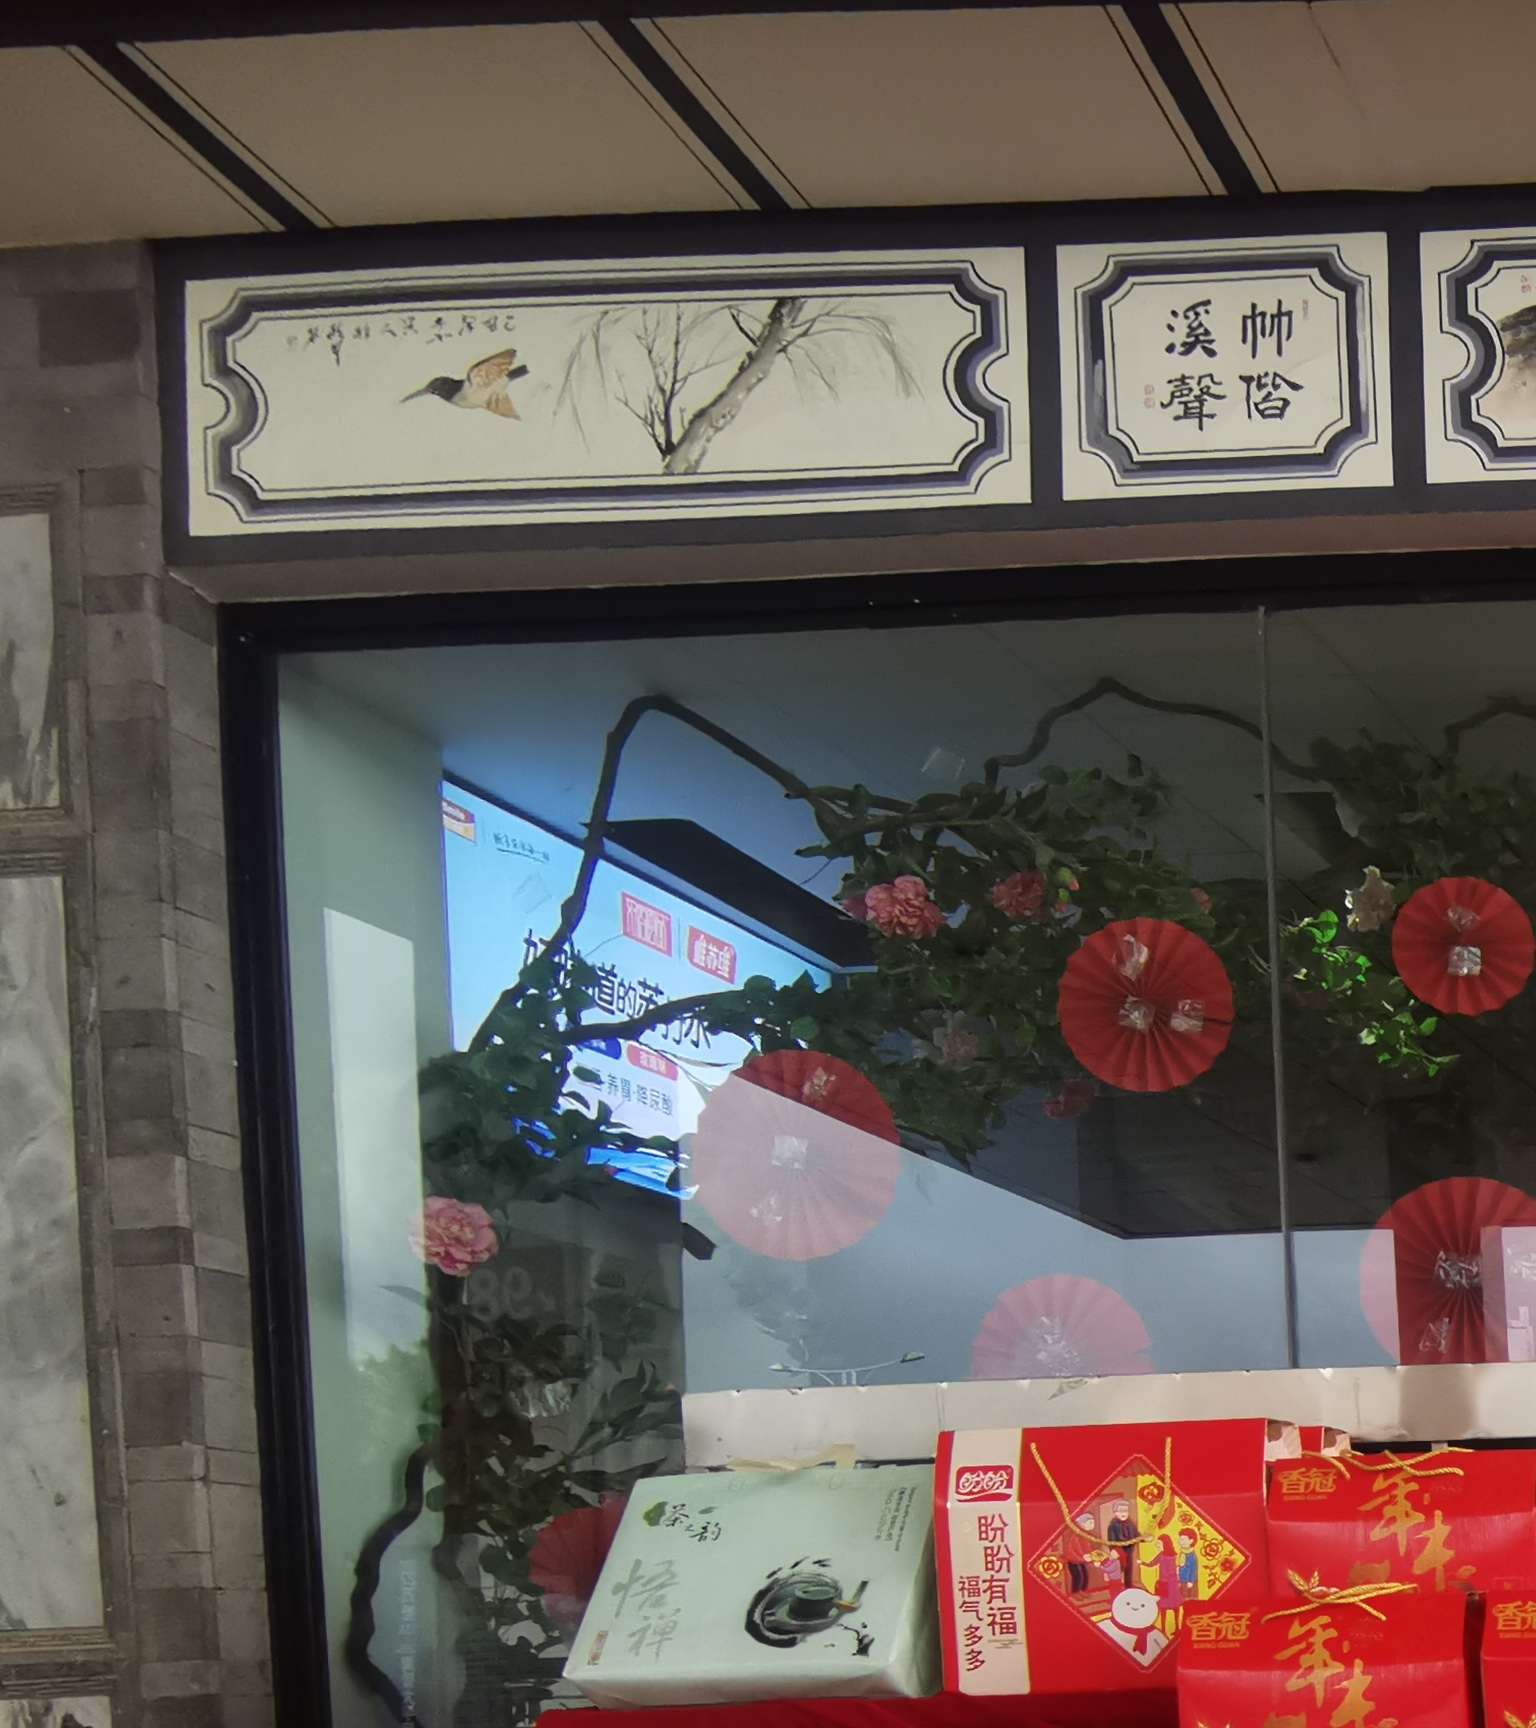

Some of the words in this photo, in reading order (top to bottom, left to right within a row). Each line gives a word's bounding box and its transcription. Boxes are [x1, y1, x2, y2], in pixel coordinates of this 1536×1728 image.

[958, 1470, 1010, 1493] 盼盼
[977, 1512, 1018, 1637] 盼盼有福
[957, 1575, 986, 1672] 福气多多
[1187, 1612, 1250, 1641] 香冠
